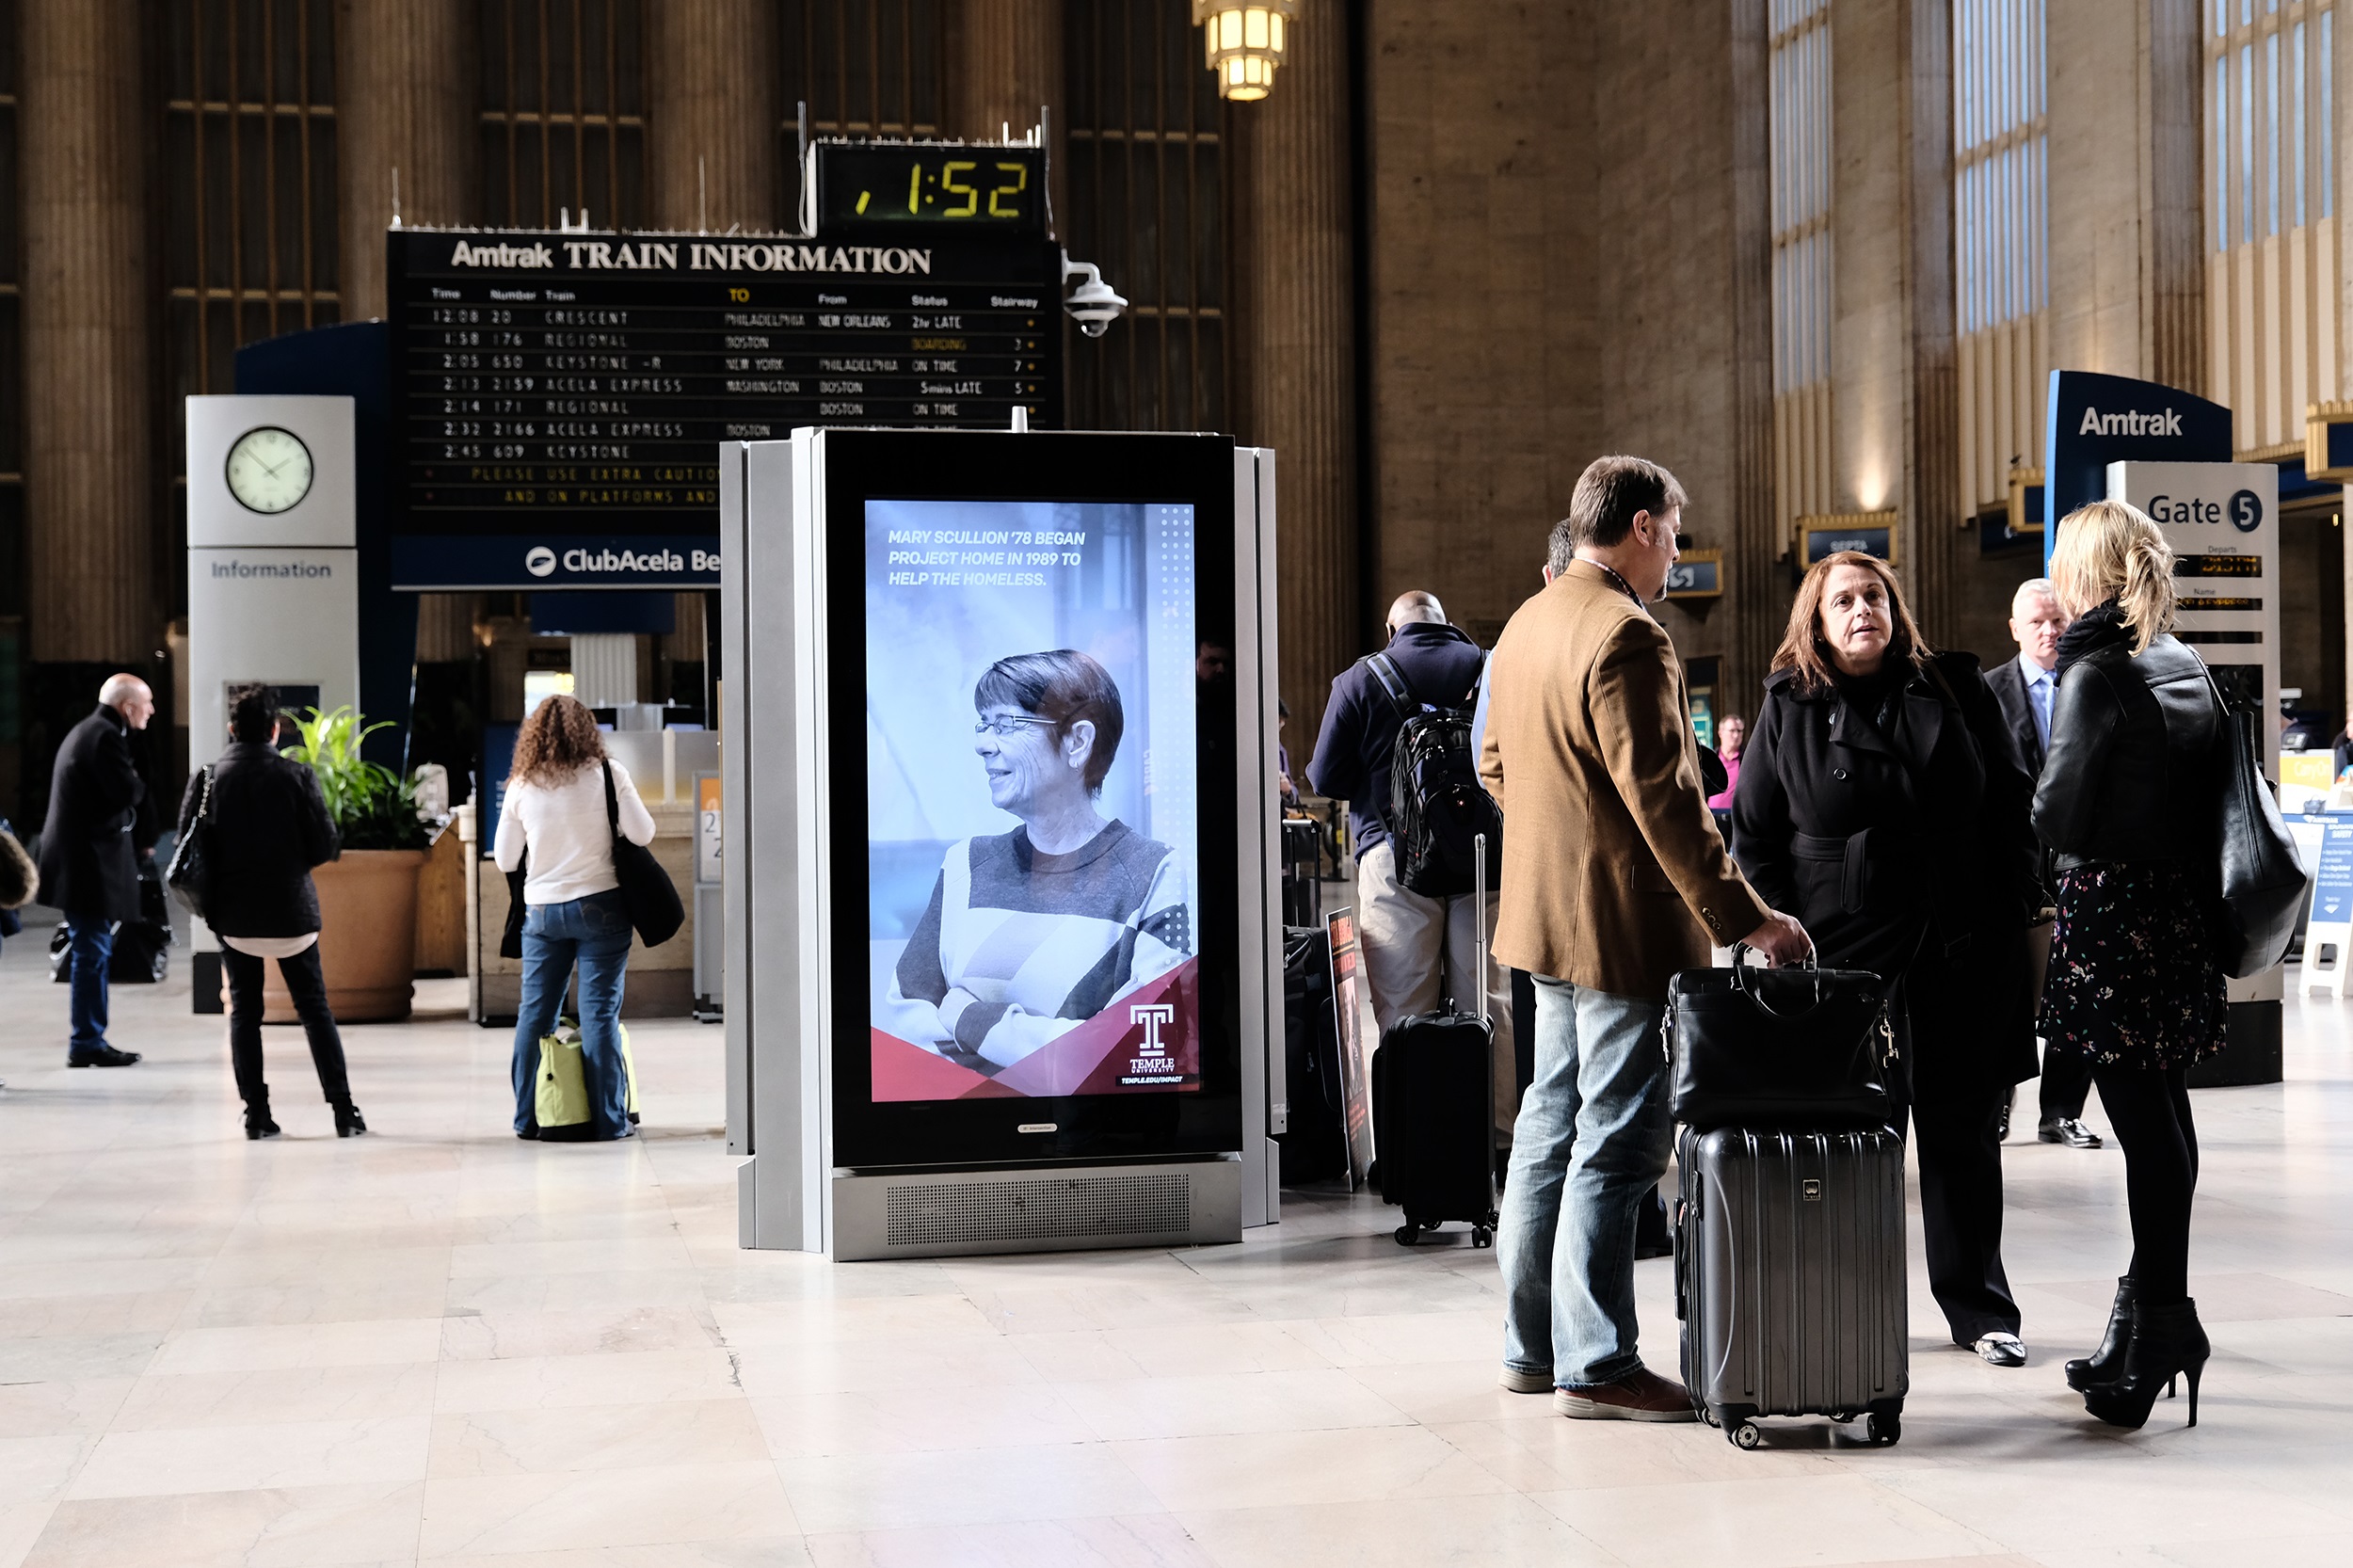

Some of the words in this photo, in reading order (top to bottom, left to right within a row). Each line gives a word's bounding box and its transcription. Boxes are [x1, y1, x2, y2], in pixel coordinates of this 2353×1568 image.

[907, 161, 1028, 217] 1:52
[451, 240, 553, 268] Amtrak
[562, 242, 679, 270] TRAIN
[689, 243, 933, 275] INFORMATION
[431, 288, 461, 299] Time
[490, 290, 536, 301] Number
[544, 290, 576, 301] Train
[728, 288, 750, 303] TO
[817, 295, 848, 306] From
[911, 295, 949, 308] Status
[989, 296, 1039, 311] Stairway
[489, 310, 512, 324] 20
[544, 311, 629, 326] CRESCENT
[725, 313, 806, 328] PHILADELPHIA
[817, 315, 841, 328] NEW
[842, 315, 892, 329] ORLEANS
[934, 315, 963, 329] LATE
[492, 332, 523, 347] 176
[544, 333, 628, 348] REGIONAL
[725, 336, 770, 350] BOSTON
[911, 337, 968, 351] BOARDING
[490, 355, 524, 370] 650
[545, 356, 629, 371] KEYSTONE
[725, 359, 751, 372] NEW
[754, 359, 785, 372] YORK
[819, 359, 900, 373] PHILADELPHIA
[911, 360, 929, 373] ON
[933, 360, 958, 373] TIME
[491, 377, 536, 392] 2159
[545, 378, 599, 392] ACELA
[609, 378, 684, 393] EXPRESS
[726, 380, 800, 393] WASHINGTON
[819, 381, 863, 394] BOSTON
[953, 381, 983, 395] LATE
[493, 399, 523, 414] 171
[545, 401, 630, 415] REGIONAL
[819, 403, 864, 416] BOSTON
[912, 403, 929, 417] ON
[934, 403, 959, 417] TIME
[2078, 407, 2183, 436] Amtrak
[546, 424, 600, 438] ACELA
[610, 424, 684, 439] EXPRESS
[726, 424, 771, 438] BOSTON
[492, 444, 525, 459] 609
[546, 445, 632, 459] KEYSTONE
[471, 467, 535, 481] PLEASE
[546, 468, 578, 482] USE
[589, 468, 642, 482] EXTRA
[653, 468, 721, 482] CAUTIO
[504, 490, 536, 504] AND
[547, 490, 568, 504] ON
[579, 490, 675, 505] PLATFORMS
[685, 490, 717, 505] AND
[2148, 494, 2221, 523] Gate
[2237, 496, 2253, 525] 5
[888, 530, 932, 544] MARY
[934, 531, 1009, 545] SCULLION
[1034, 532, 1085, 546] BEGAN
[563, 548, 684, 571] ClubAcela
[888, 552, 959, 566] PROJECT
[960, 552, 1004, 566] HOME
[1005, 552, 1023, 566] IN
[1025, 552, 1059, 566] 1989
[1061, 552, 1081, 566] TO
[2207, 546, 2237, 557] Departs
[211, 560, 331, 579] Information
[888, 572, 929, 585] HELP
[931, 572, 961, 585] THE
[963, 572, 1048, 586] HOMELESS.
[1129, 1058, 1175, 1068] TEMPLE
[1121, 1076, 1183, 1084] TEMPLE.EDU/IMPACT
